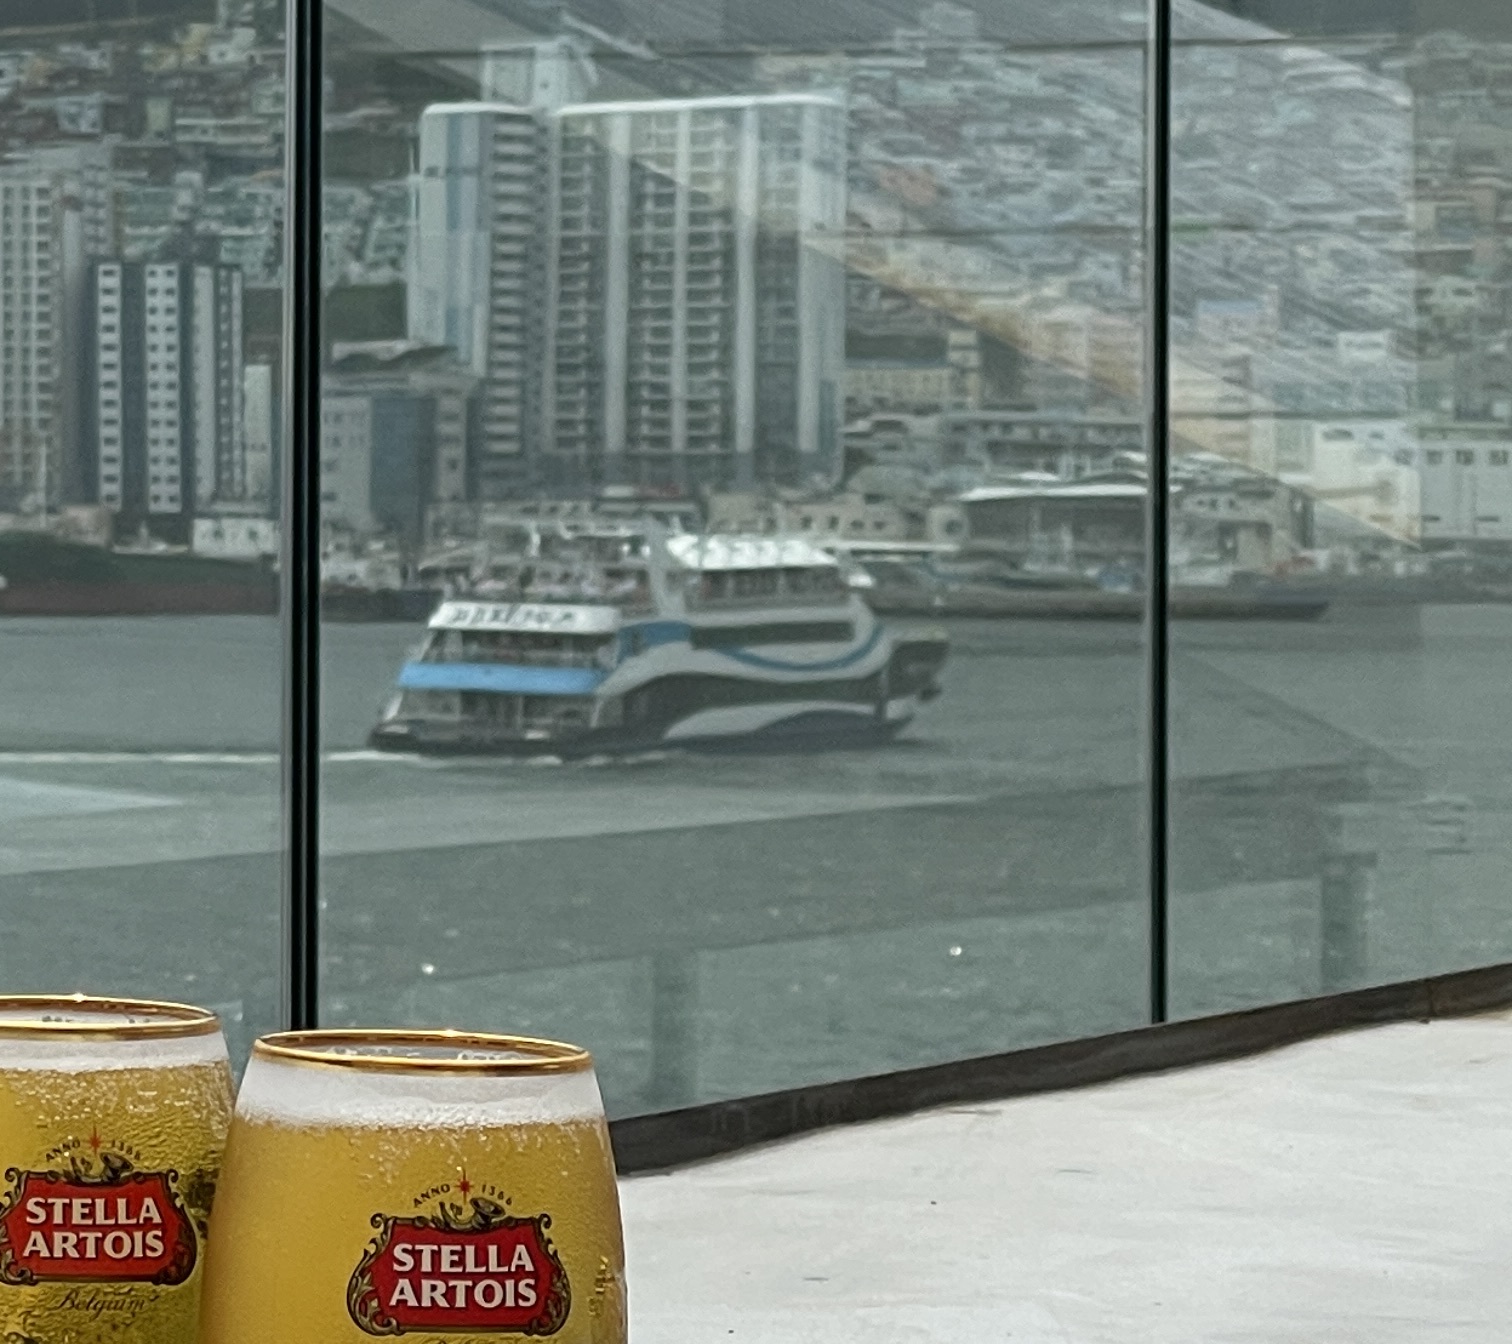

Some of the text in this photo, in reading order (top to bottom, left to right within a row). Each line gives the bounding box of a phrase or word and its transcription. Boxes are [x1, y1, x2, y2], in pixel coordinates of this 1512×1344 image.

[46, 1138, 81, 1162] ANNO
[412, 1183, 514, 1208] ANNO 1366
[25, 1196, 163, 1226] STELLA
[22, 1229, 165, 1259] ARTOIS
[392, 1242, 536, 1273] STELLA
[389, 1278, 538, 1309] ARTOIS
